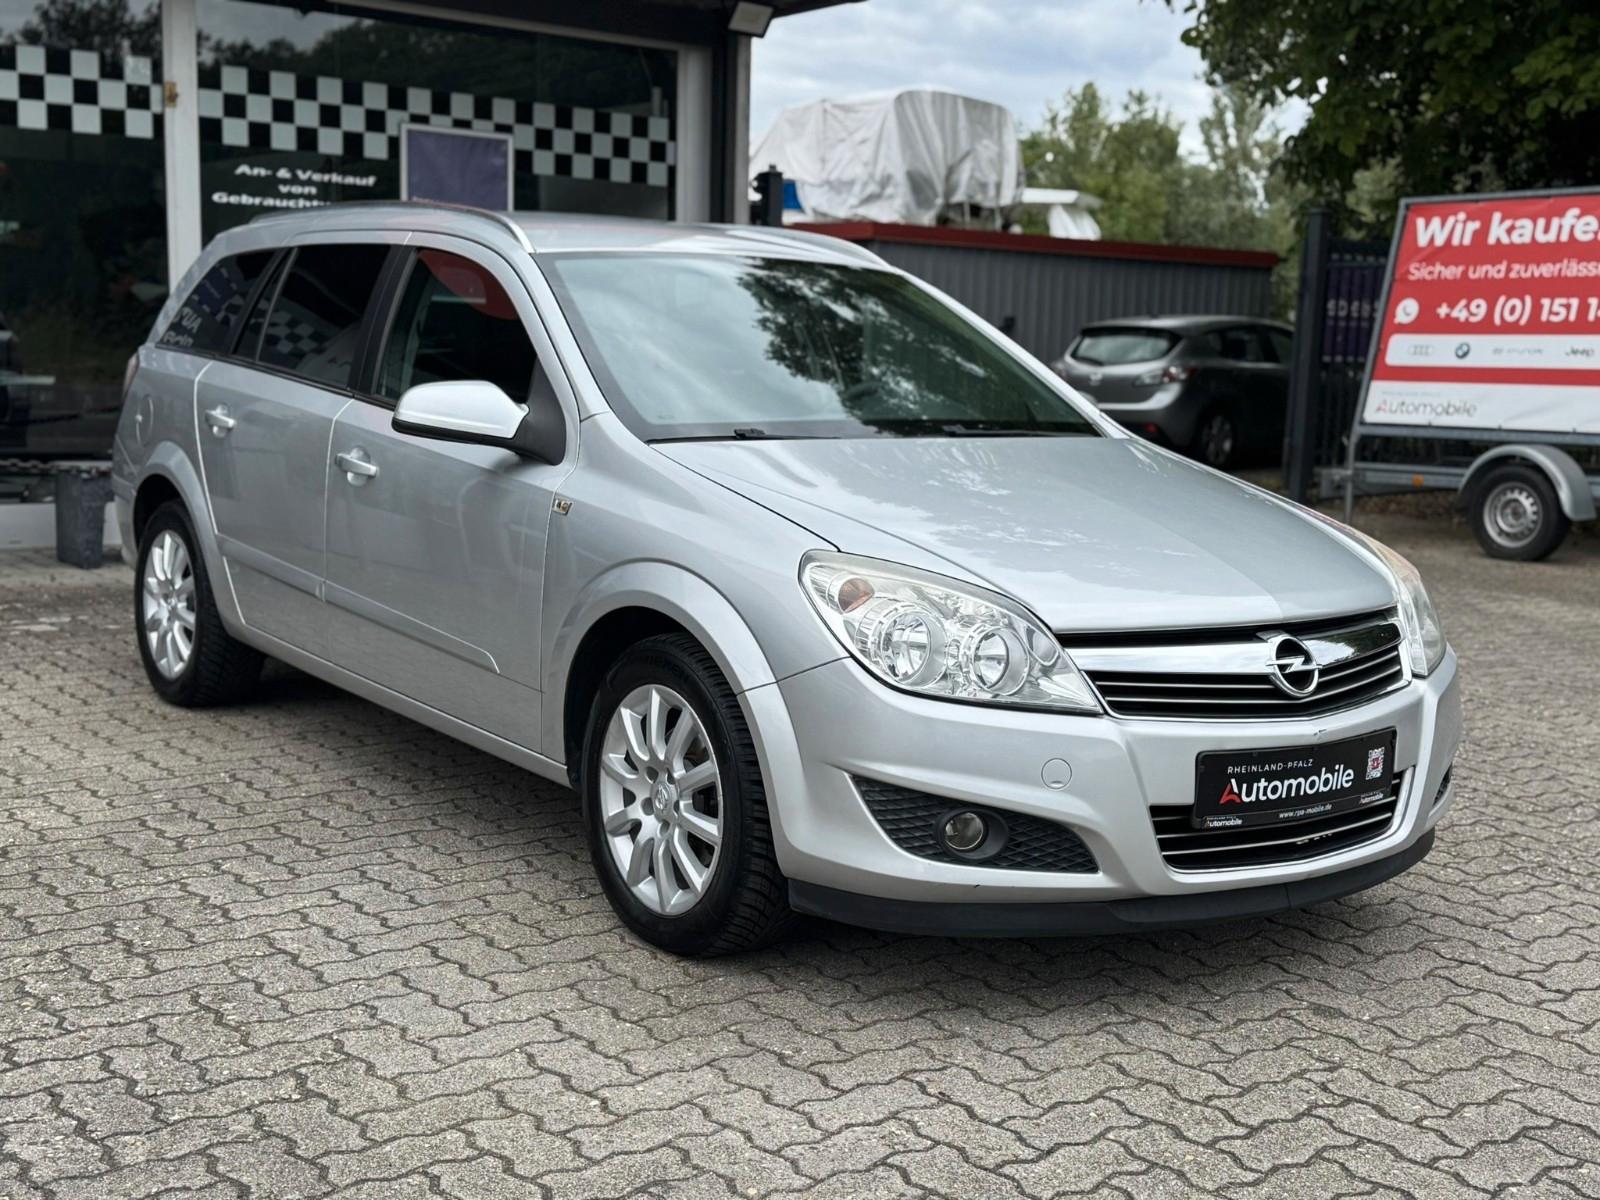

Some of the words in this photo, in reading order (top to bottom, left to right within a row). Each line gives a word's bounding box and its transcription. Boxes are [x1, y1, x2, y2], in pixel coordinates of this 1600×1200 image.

[235, 163, 273, 177] An-
[276, 167, 292, 179] &
[296, 169, 377, 187] Verkauf
[277, 184, 318, 195] von
[1416, 211, 1481, 248] Wir
[1487, 207, 1600, 246] kaufe
[1408, 262, 1464, 281] Sicher
[1468, 261, 1505, 279] und
[1436, 298, 1488, 323] +49
[1494, 295, 1532, 326] (0)
[1540, 298, 1579, 322] 151
[1587, 297, 1600, 322] 1
[1375, 400, 1477, 417] Automobile
[1227, 758, 1314, 774] RHEINLAND-PFALZ
[1219, 764, 1355, 804] Automobile
